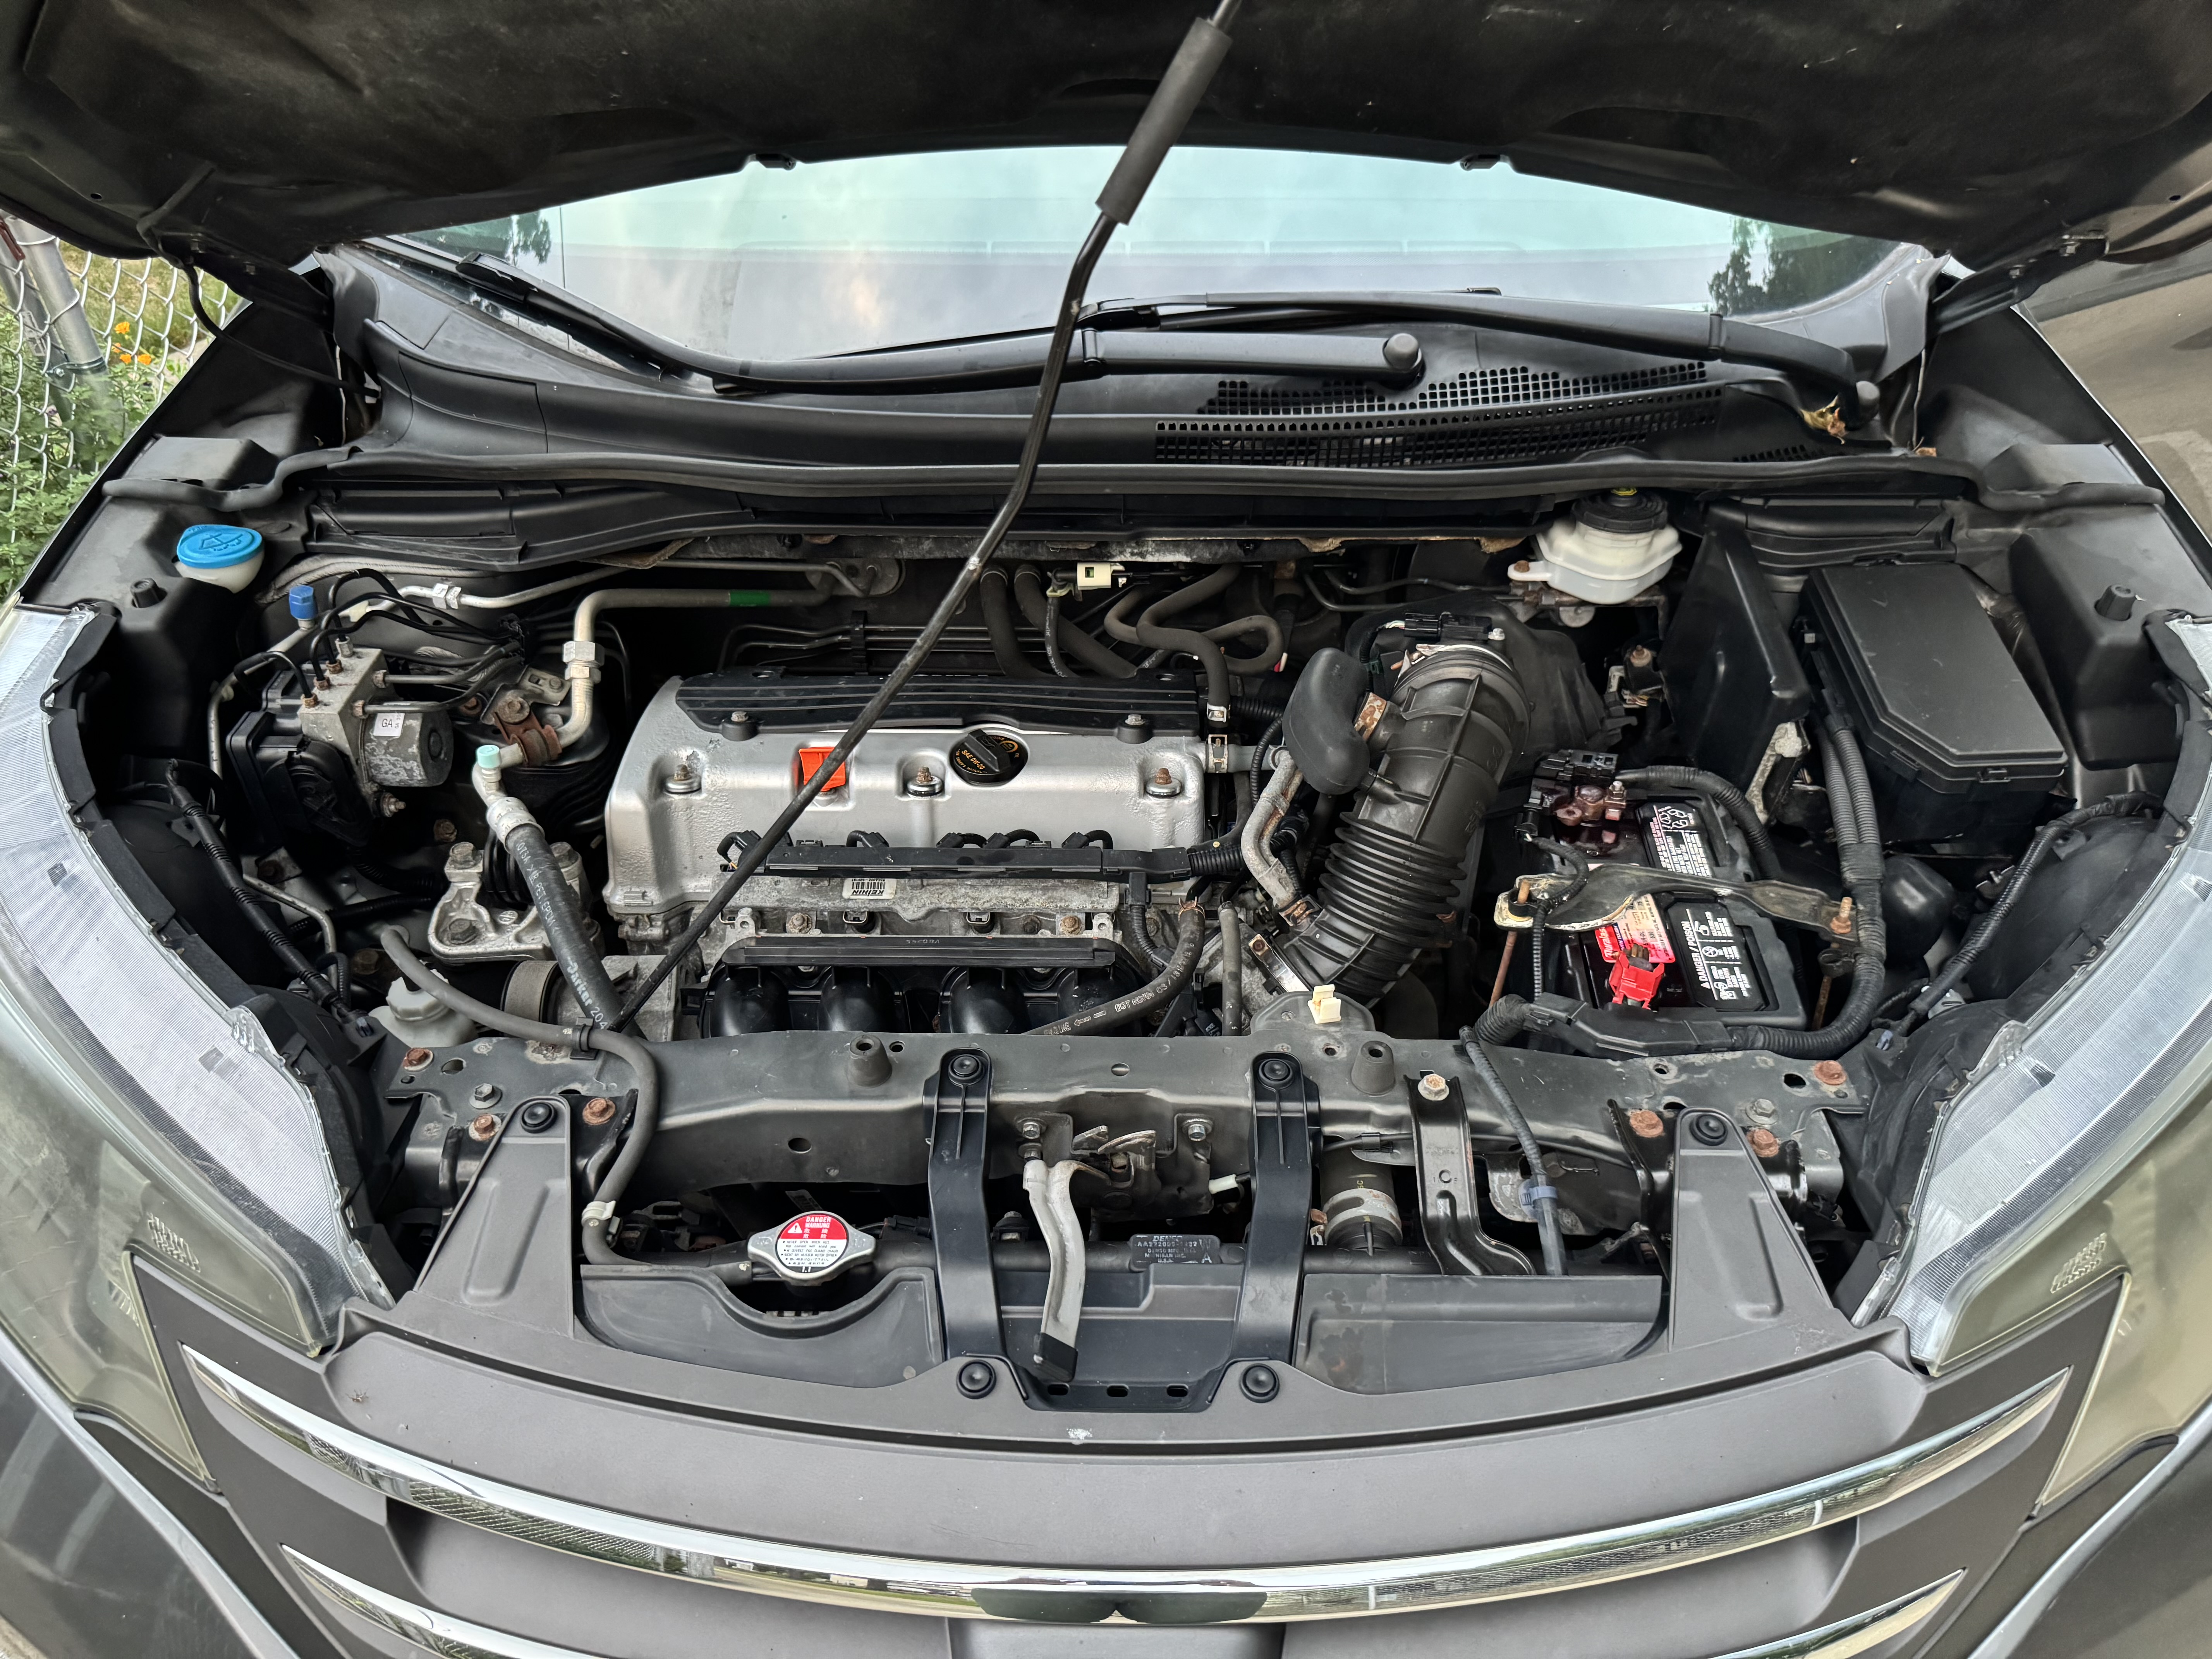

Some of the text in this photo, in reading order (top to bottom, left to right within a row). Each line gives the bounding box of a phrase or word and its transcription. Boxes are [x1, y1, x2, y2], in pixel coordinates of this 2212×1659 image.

[382, 718, 393, 727] GA
[962, 750, 985, 769] SAE 0W-20
[1681, 921, 1697, 946] POISON
[1691, 952, 1708, 981] DANGER
[590, 1006, 609, 1030] 204
